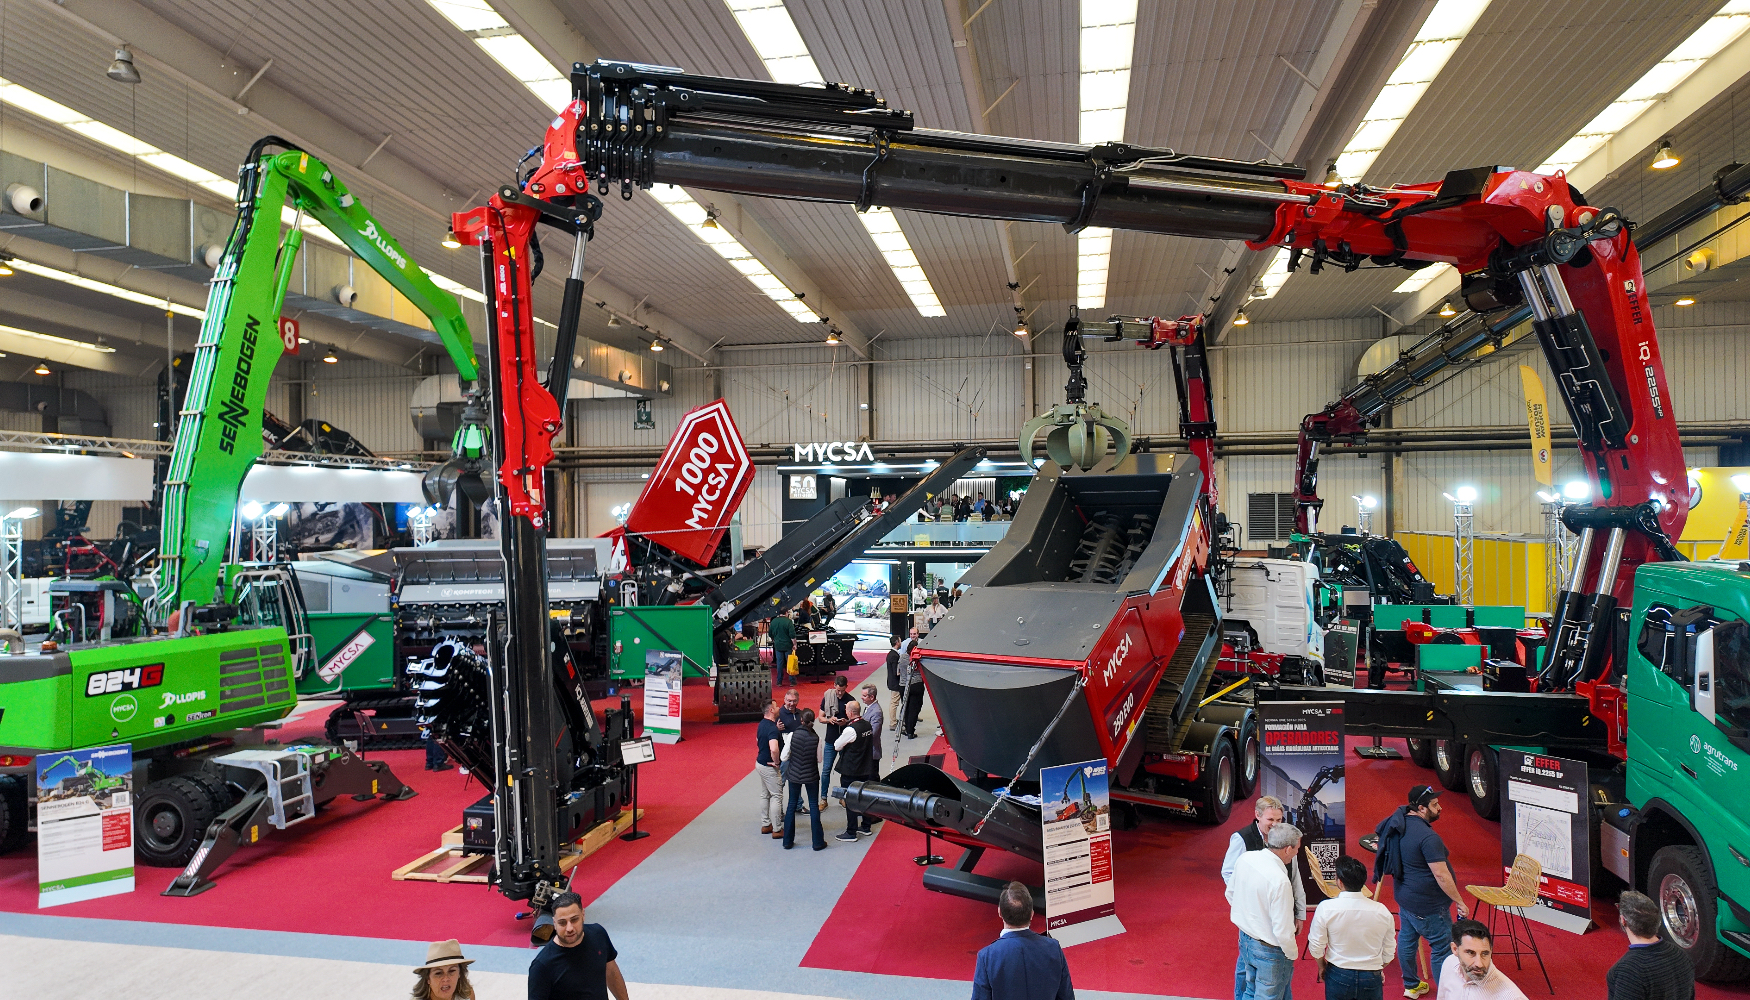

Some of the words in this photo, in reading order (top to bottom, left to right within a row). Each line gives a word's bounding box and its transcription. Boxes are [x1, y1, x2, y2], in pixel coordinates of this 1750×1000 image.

[376, 235, 407, 269] LLOPIS
[1628, 293, 1643, 325] EFFER
[284, 321, 296, 350] 8
[218, 313, 261, 456] SENNEBOGEN
[675, 431, 719, 496] 1000
[794, 441, 875, 463] MYCSA
[684, 463, 735, 530] MYCSA
[453, 588, 494, 596] KOMPTECH
[328, 643, 365, 673] MYCSA
[1103, 632, 1133, 688] MYCSA
[113, 703, 135, 714] MYCSA
[176, 690, 206, 704] LLOPIS
[1113, 709, 1124, 738] 250
[1123, 692, 1134, 720] EVO
[1265, 731, 1339, 746] OPERADORES
[1521, 765, 1536, 774] EFFER
[1535, 756, 1561, 771] EFFER
[1703, 741, 1738, 771] agrutrans
[41, 883, 66, 893] MYCSA
[1050, 918, 1068, 928] MYCSA
